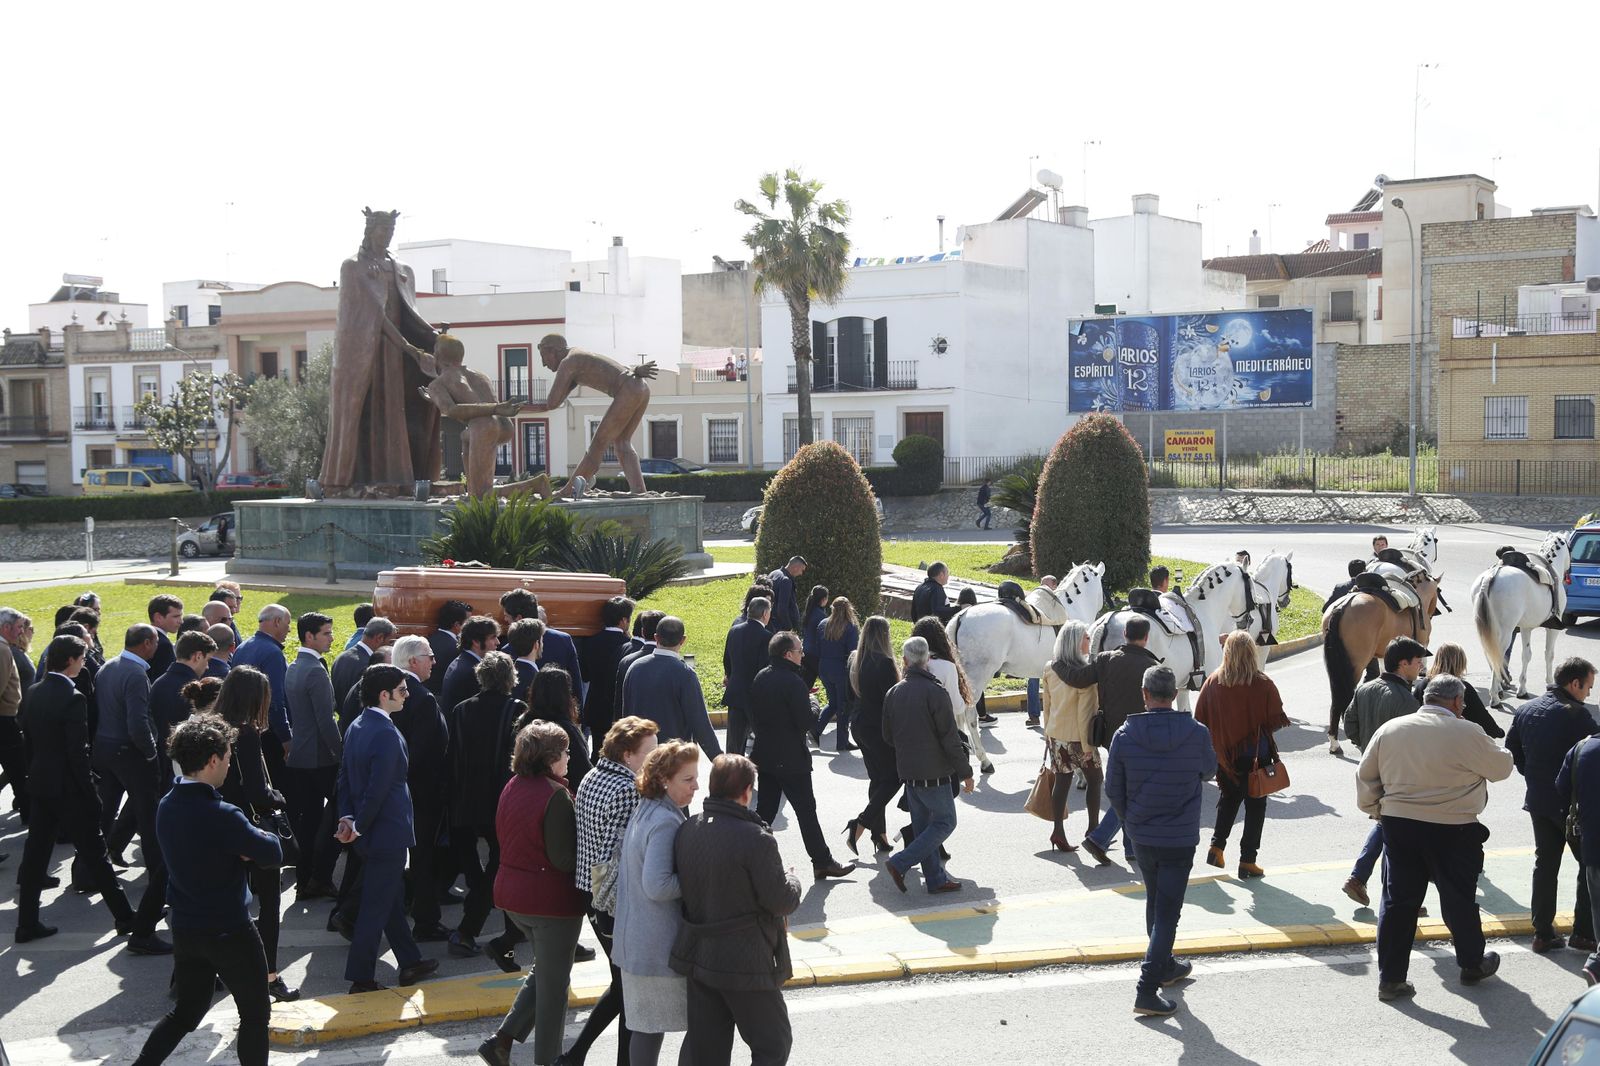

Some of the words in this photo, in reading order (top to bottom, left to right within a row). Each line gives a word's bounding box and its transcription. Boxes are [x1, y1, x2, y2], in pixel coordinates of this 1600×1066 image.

[1117, 346, 1158, 366] LARIOS
[1074, 363, 1114, 378] ESPÍRITU
[1190, 366, 1217, 378] LARIOS
[1236, 356, 1311, 373] MEDITERRÁNEO
[1122, 368, 1149, 391] 12
[1166, 436, 1214, 446] CAMARON
